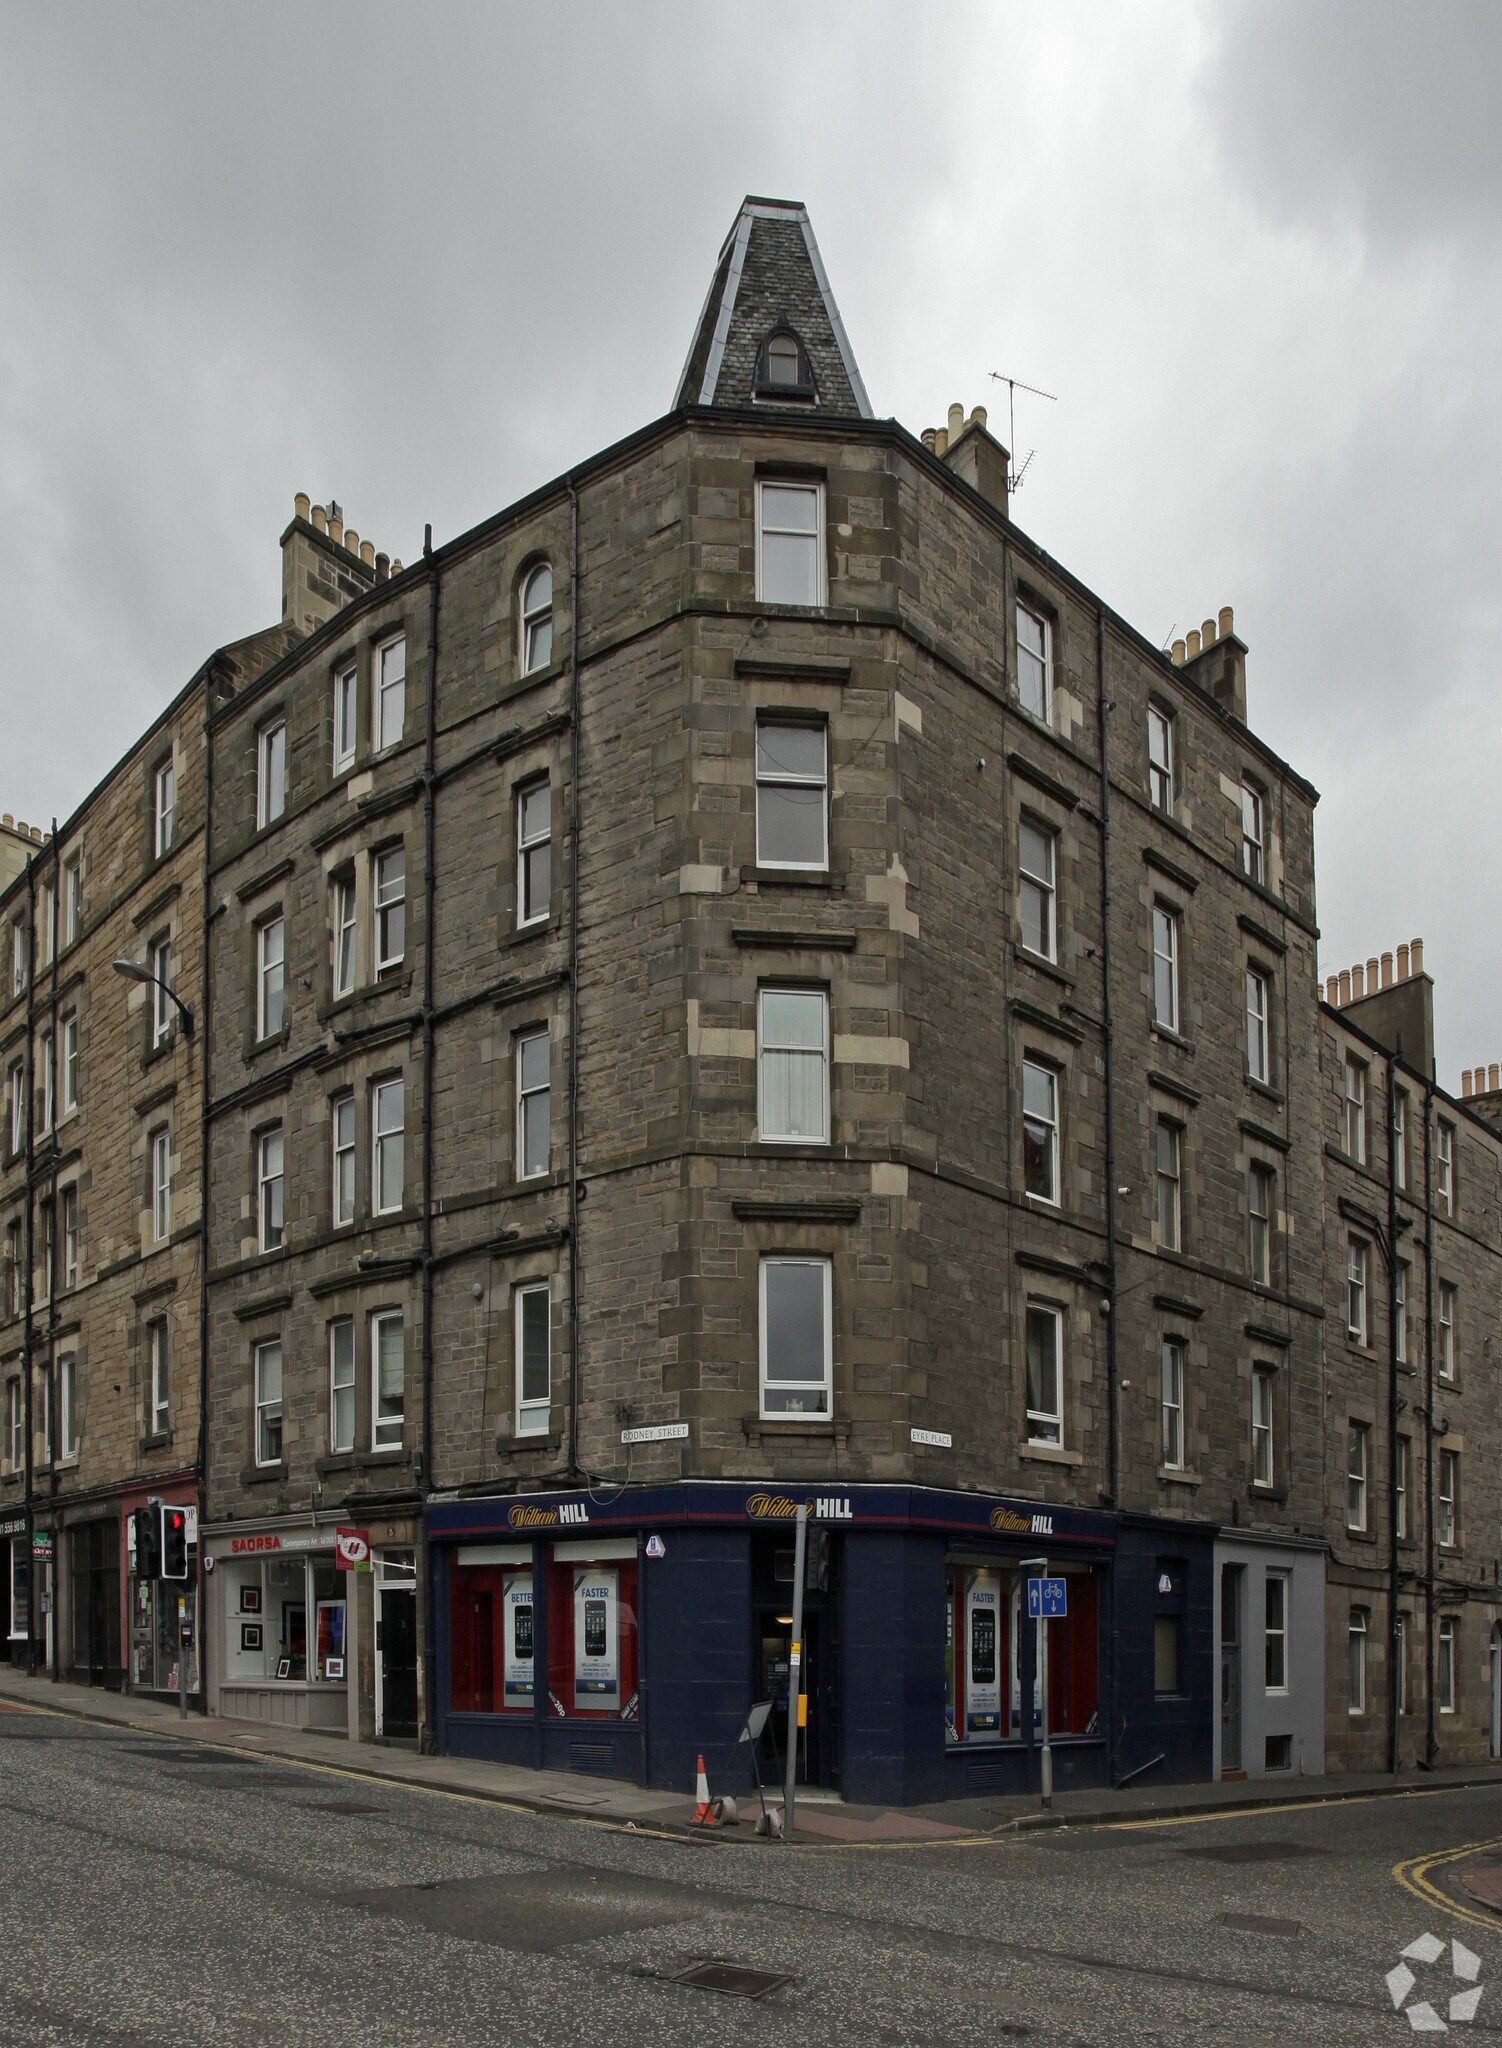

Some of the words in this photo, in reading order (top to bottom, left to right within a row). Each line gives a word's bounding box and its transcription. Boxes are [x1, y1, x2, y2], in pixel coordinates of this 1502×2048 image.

[623, 1430, 654, 1441] RODNEY
[658, 1426, 687, 1438] STREET
[912, 1431, 929, 1442] EYRE
[931, 1433, 951, 1445] PLACE
[508, 1504, 559, 1527] William
[559, 1503, 589, 1524] HILL
[816, 1498, 853, 1518] HILL
[990, 1506, 1032, 1532] William
[1031, 1514, 1053, 1535] HILL
[231, 1536, 281, 1553] SAORSA
[581, 1588, 609, 1598] FASTER
[972, 1592, 995, 1604] FASTER
